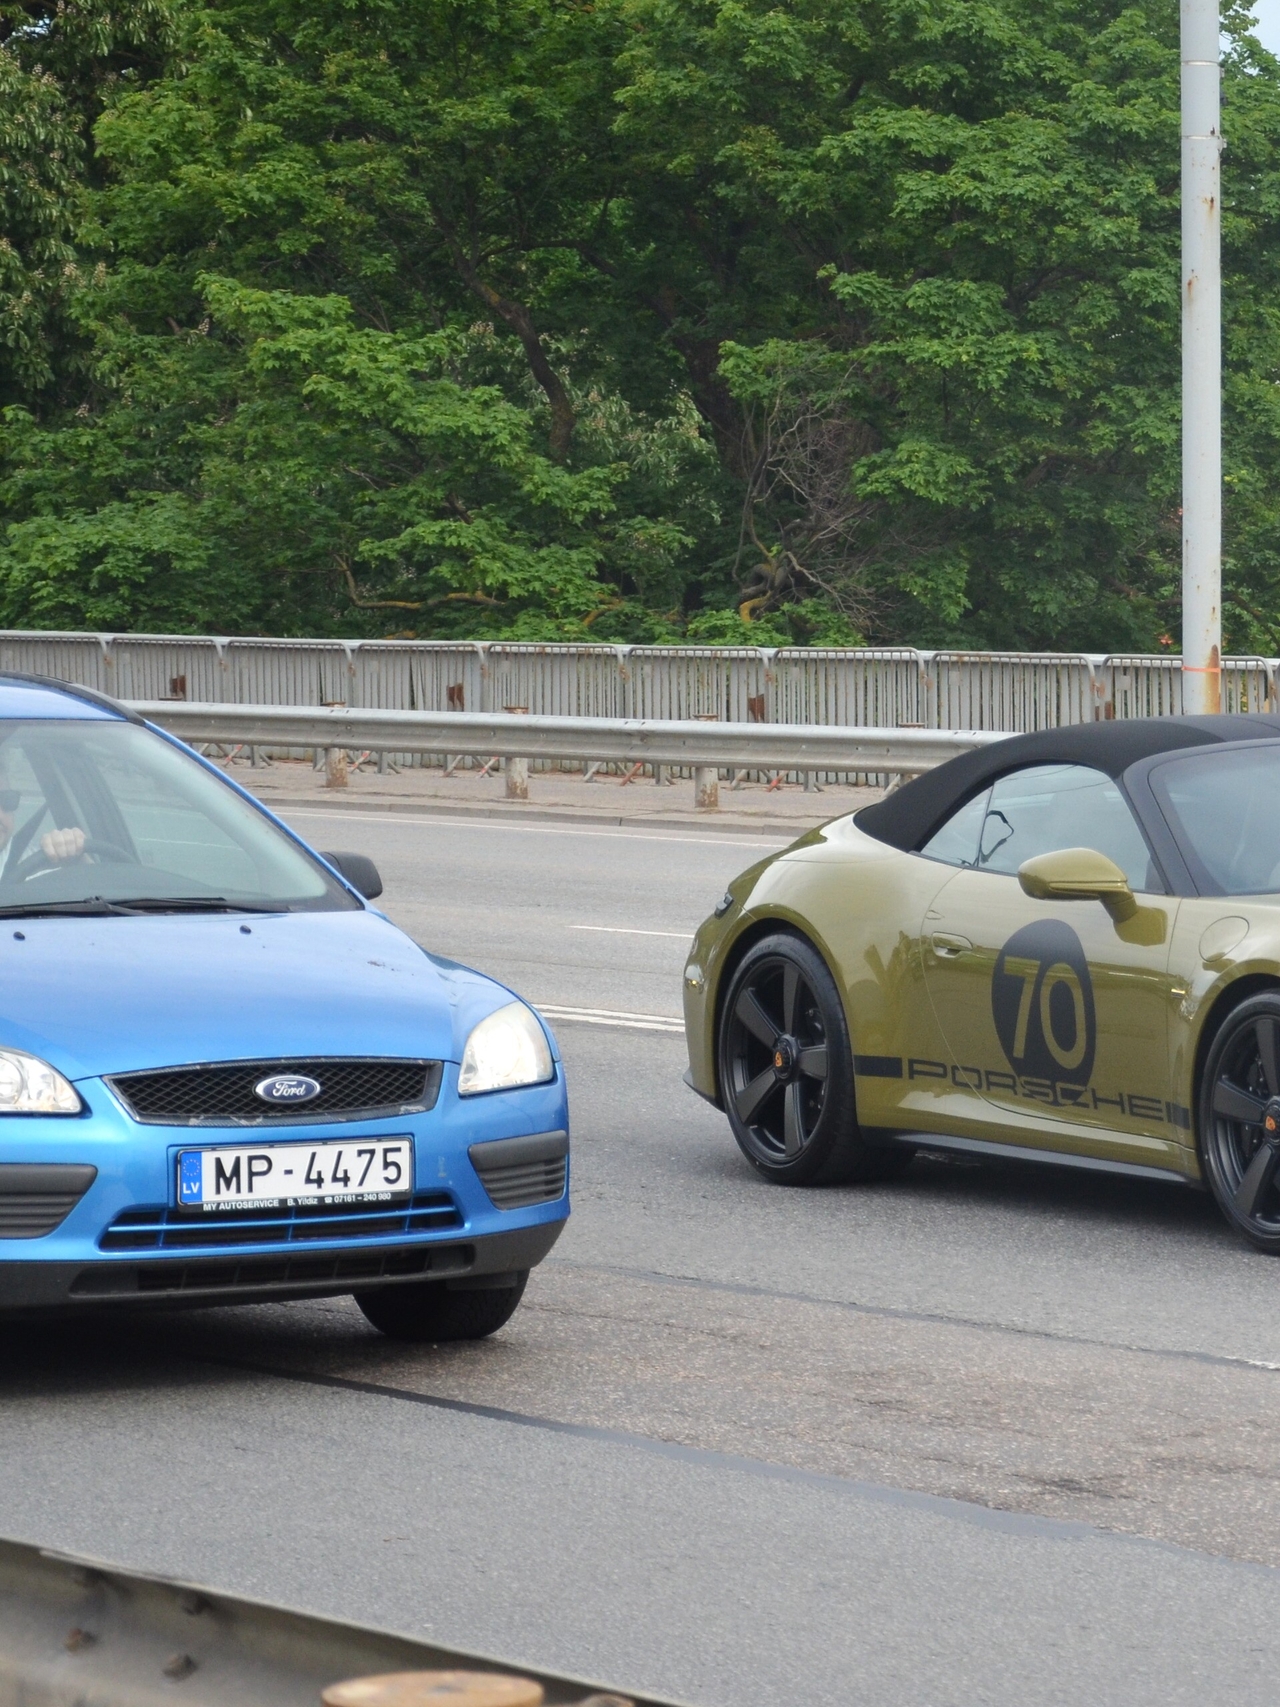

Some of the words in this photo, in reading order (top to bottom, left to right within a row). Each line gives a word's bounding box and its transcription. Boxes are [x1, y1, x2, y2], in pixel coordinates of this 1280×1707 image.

[1004, 955, 1087, 1070] 70
[272, 1080, 306, 1097] Ford
[908, 1057, 1164, 1123] PORSCHE
[182, 1182, 200, 1194] LV
[203, 1202, 217, 1211] MY
[218, 1199, 279, 1210] AUTOSERVICE
